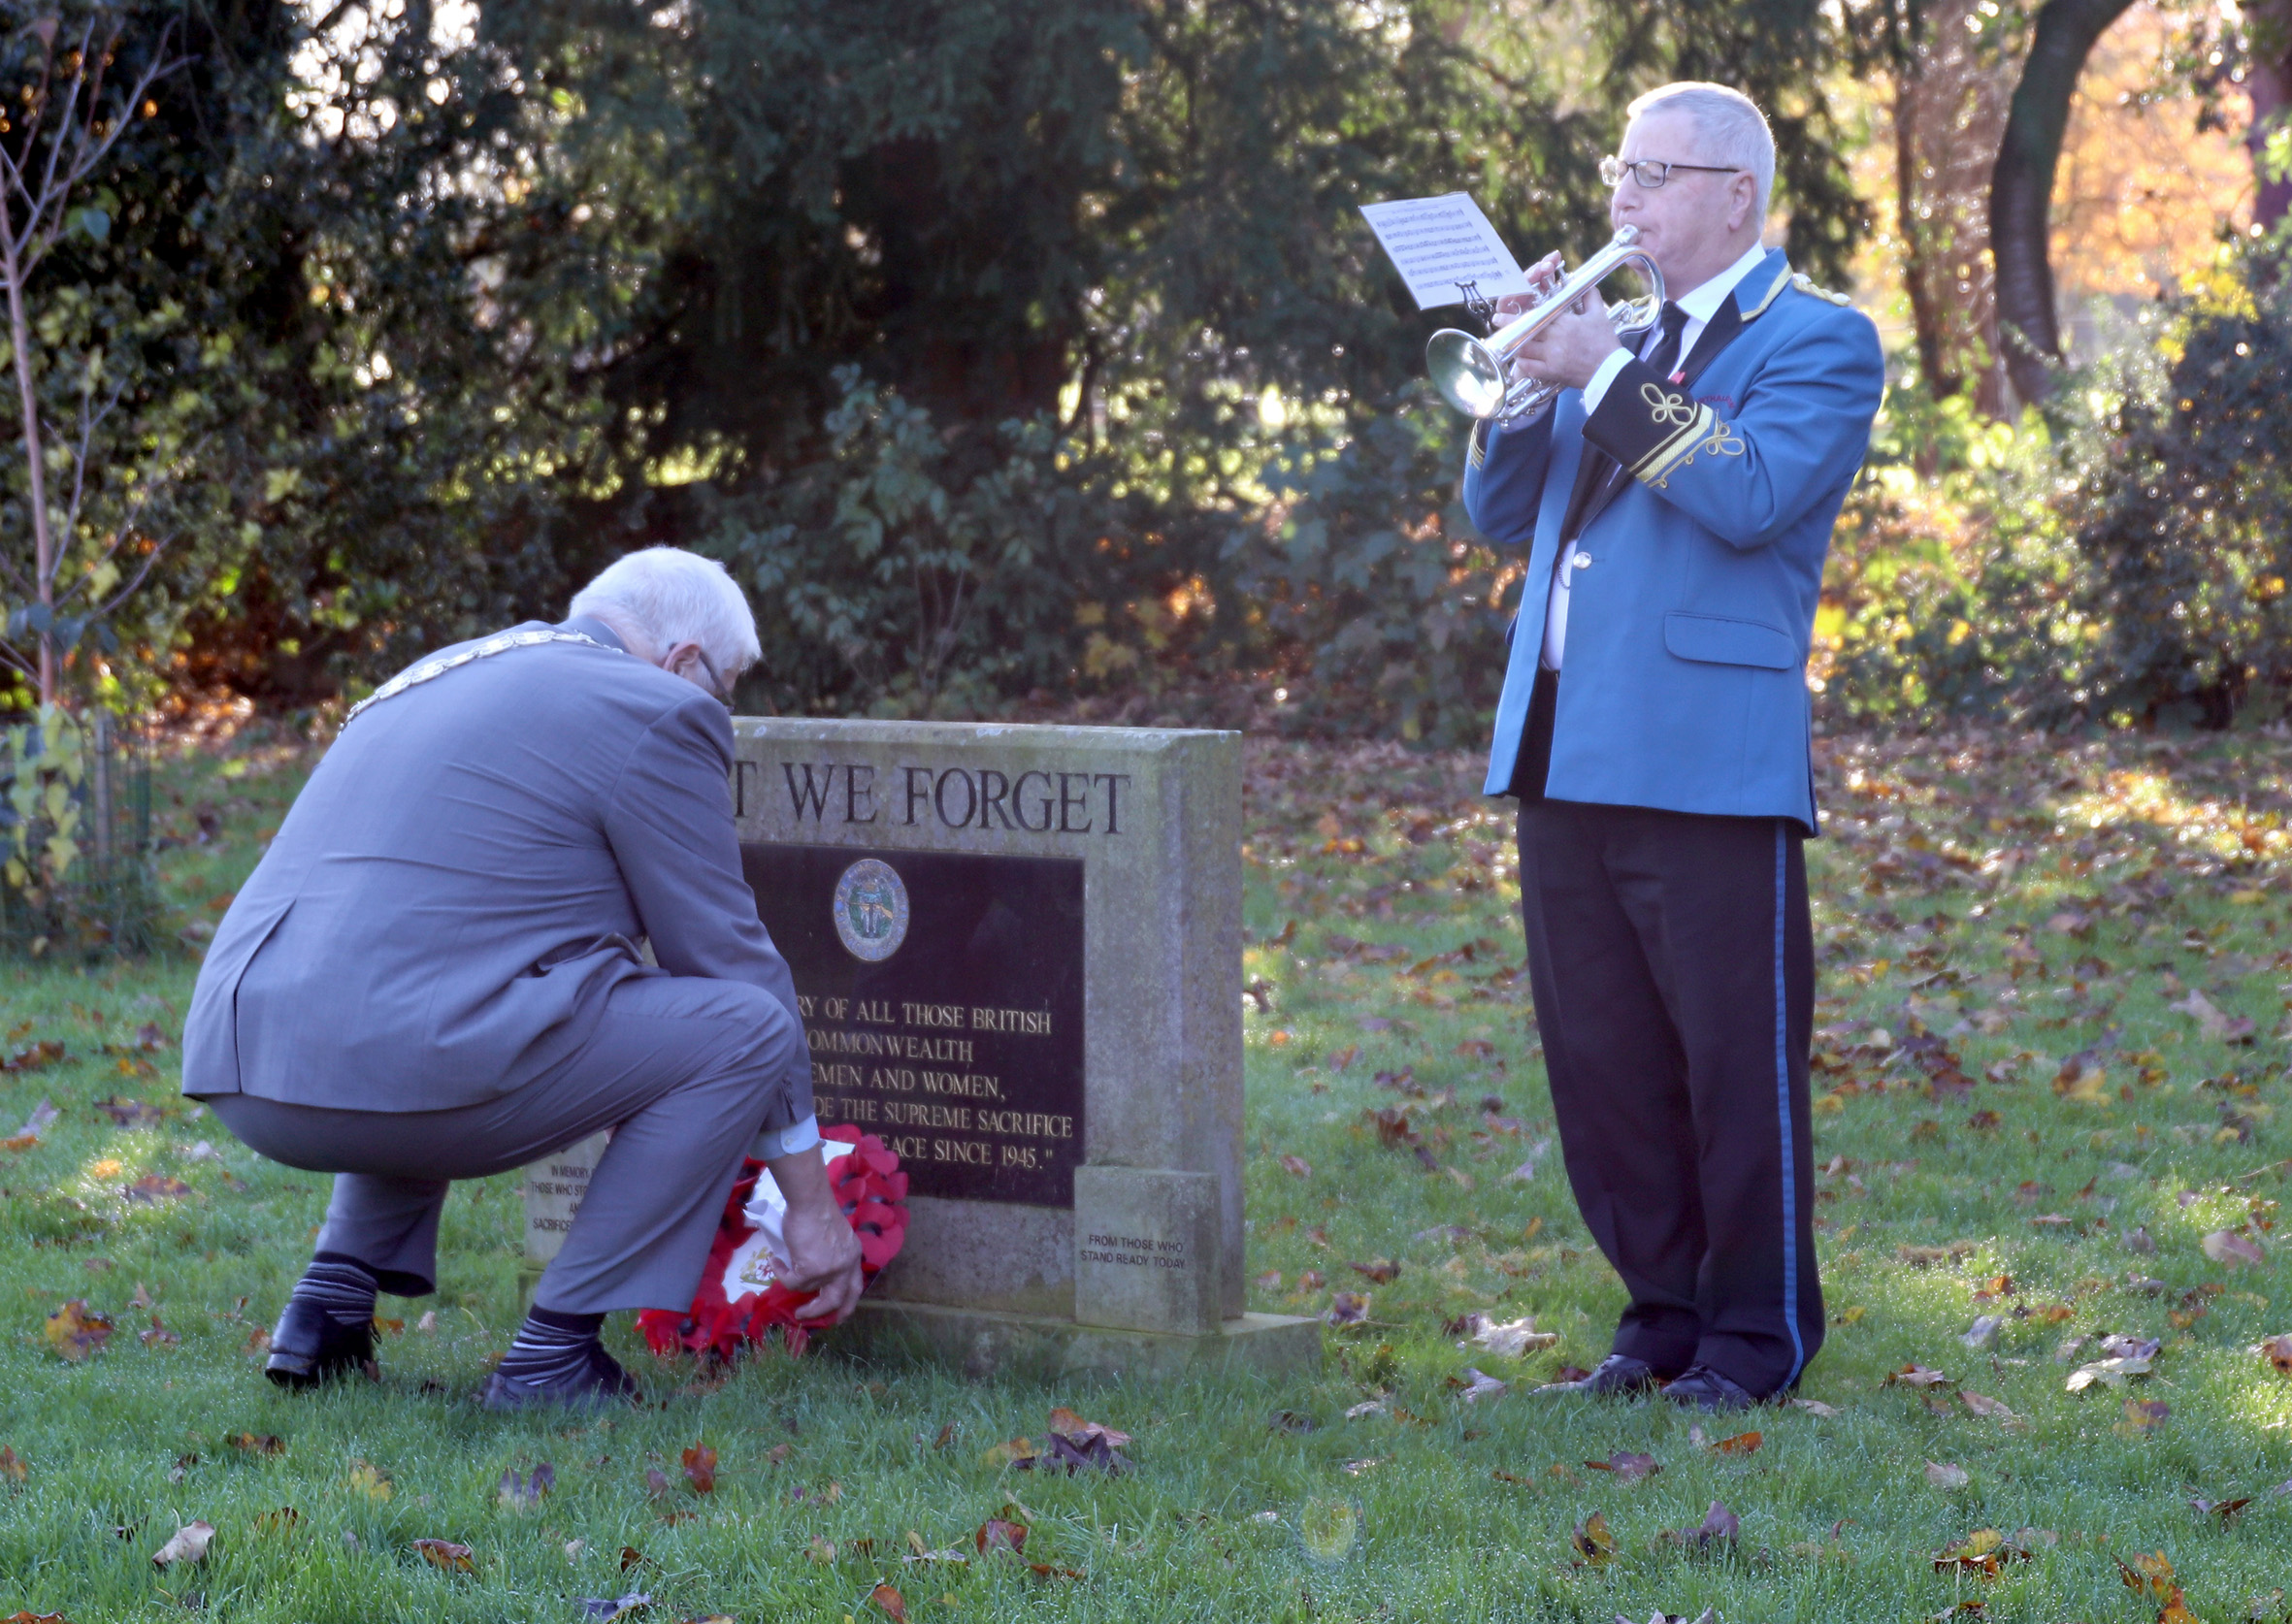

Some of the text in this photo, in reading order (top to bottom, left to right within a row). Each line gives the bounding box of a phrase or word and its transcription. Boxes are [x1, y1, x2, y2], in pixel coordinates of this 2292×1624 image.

[780, 762, 878, 824] WE
[900, 766, 1132, 835] FORGET
[824, 996, 849, 1020] OF
[856, 999, 895, 1023] ALL
[901, 1002, 965, 1027] THOSE
[972, 1007, 1052, 1035] BRITISH
[804, 1028, 974, 1063] OMMONWEALTH
[870, 1067, 915, 1090] AND
[922, 1070, 1006, 1102] WOMEN,
[840, 1097, 878, 1121] THE
[884, 1100, 971, 1129] SUPREME
[978, 1109, 1073, 1138] SACRIFICE
[934, 1139, 993, 1165] SINCE
[551, 1164, 559, 1177] IN
[559, 1165, 590, 1180] MEMORY
[531, 1181, 554, 1195] THOSE
[555, 1182, 573, 1196] WHO
[533, 1217, 573, 1233] SACRIFICE
[1088, 1234, 1184, 1254] FROM THOSE WHO
[1080, 1250, 1186, 1270] STAND READY TODAY
